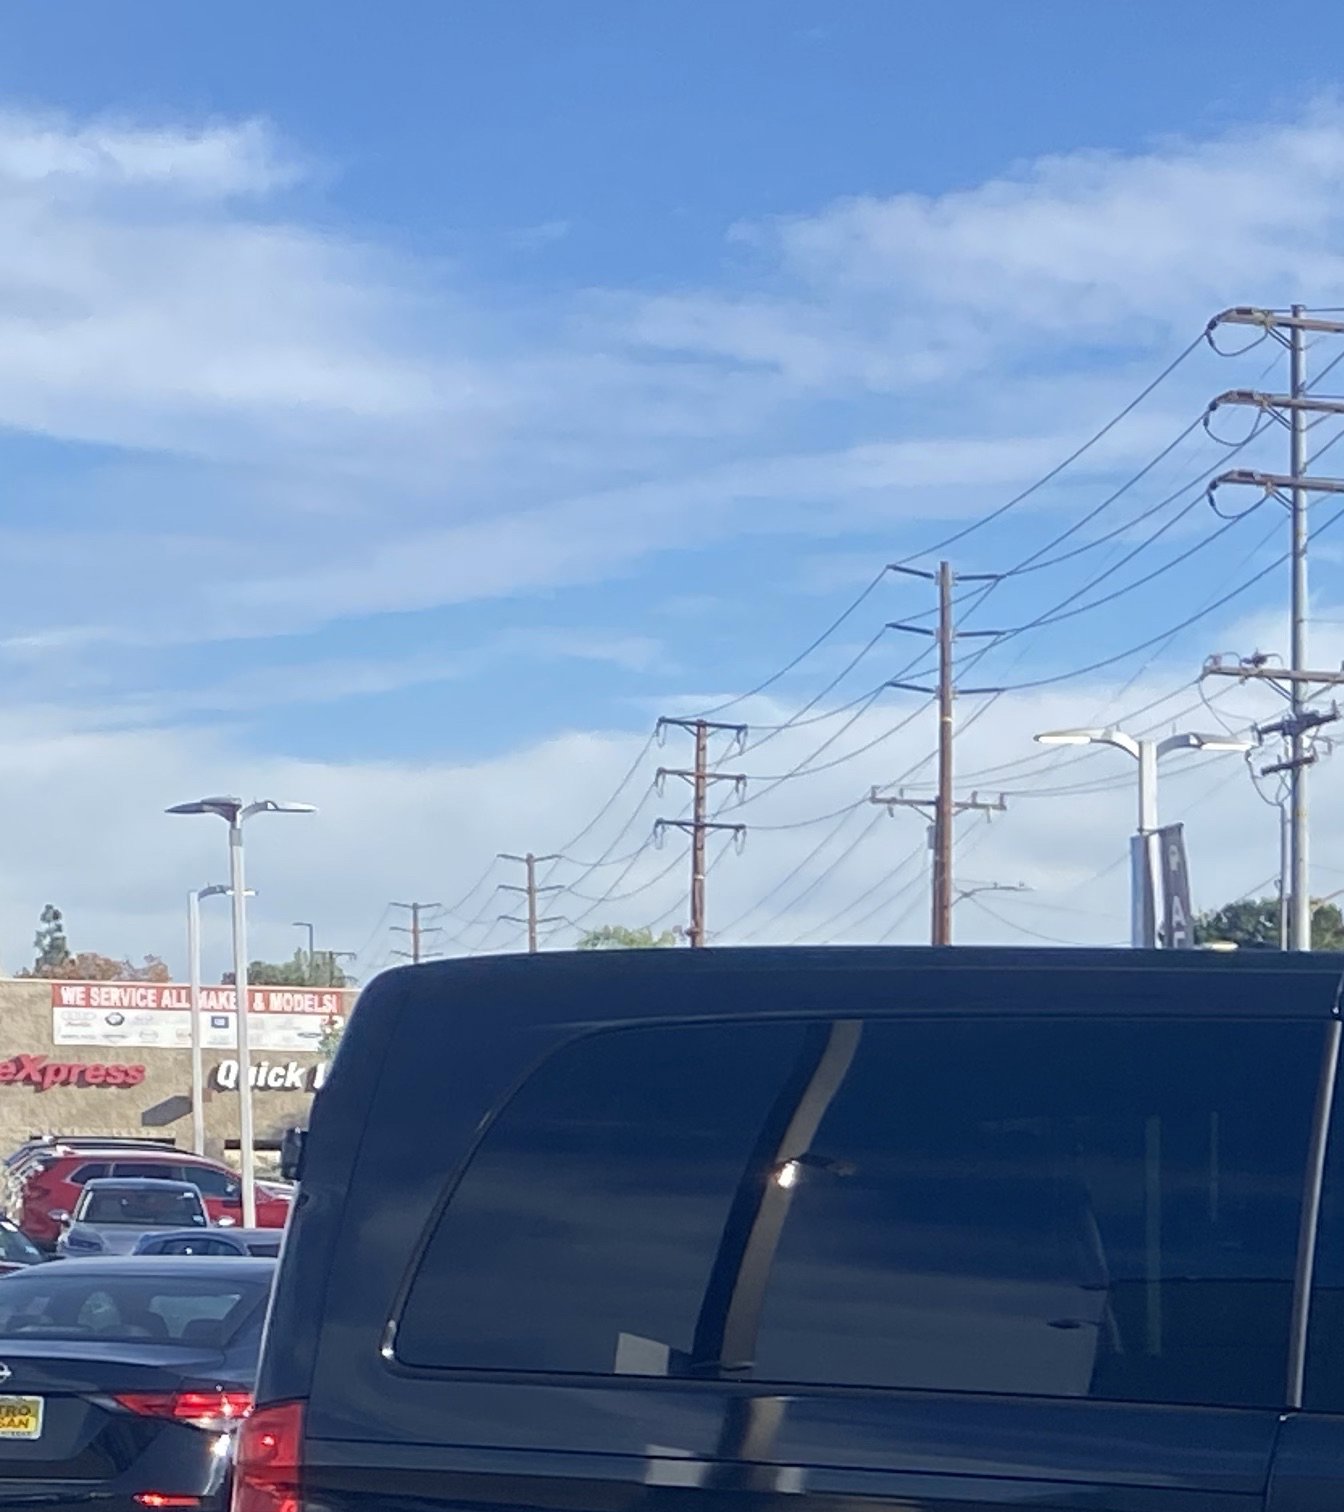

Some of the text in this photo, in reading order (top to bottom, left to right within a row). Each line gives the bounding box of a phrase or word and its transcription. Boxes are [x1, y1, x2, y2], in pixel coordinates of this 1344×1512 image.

[60, 986, 86, 1006] WE
[89, 987, 157, 1008] SERVICE
[160, 989, 190, 1008] ALL
[198, 990, 237, 1010] MAKE
